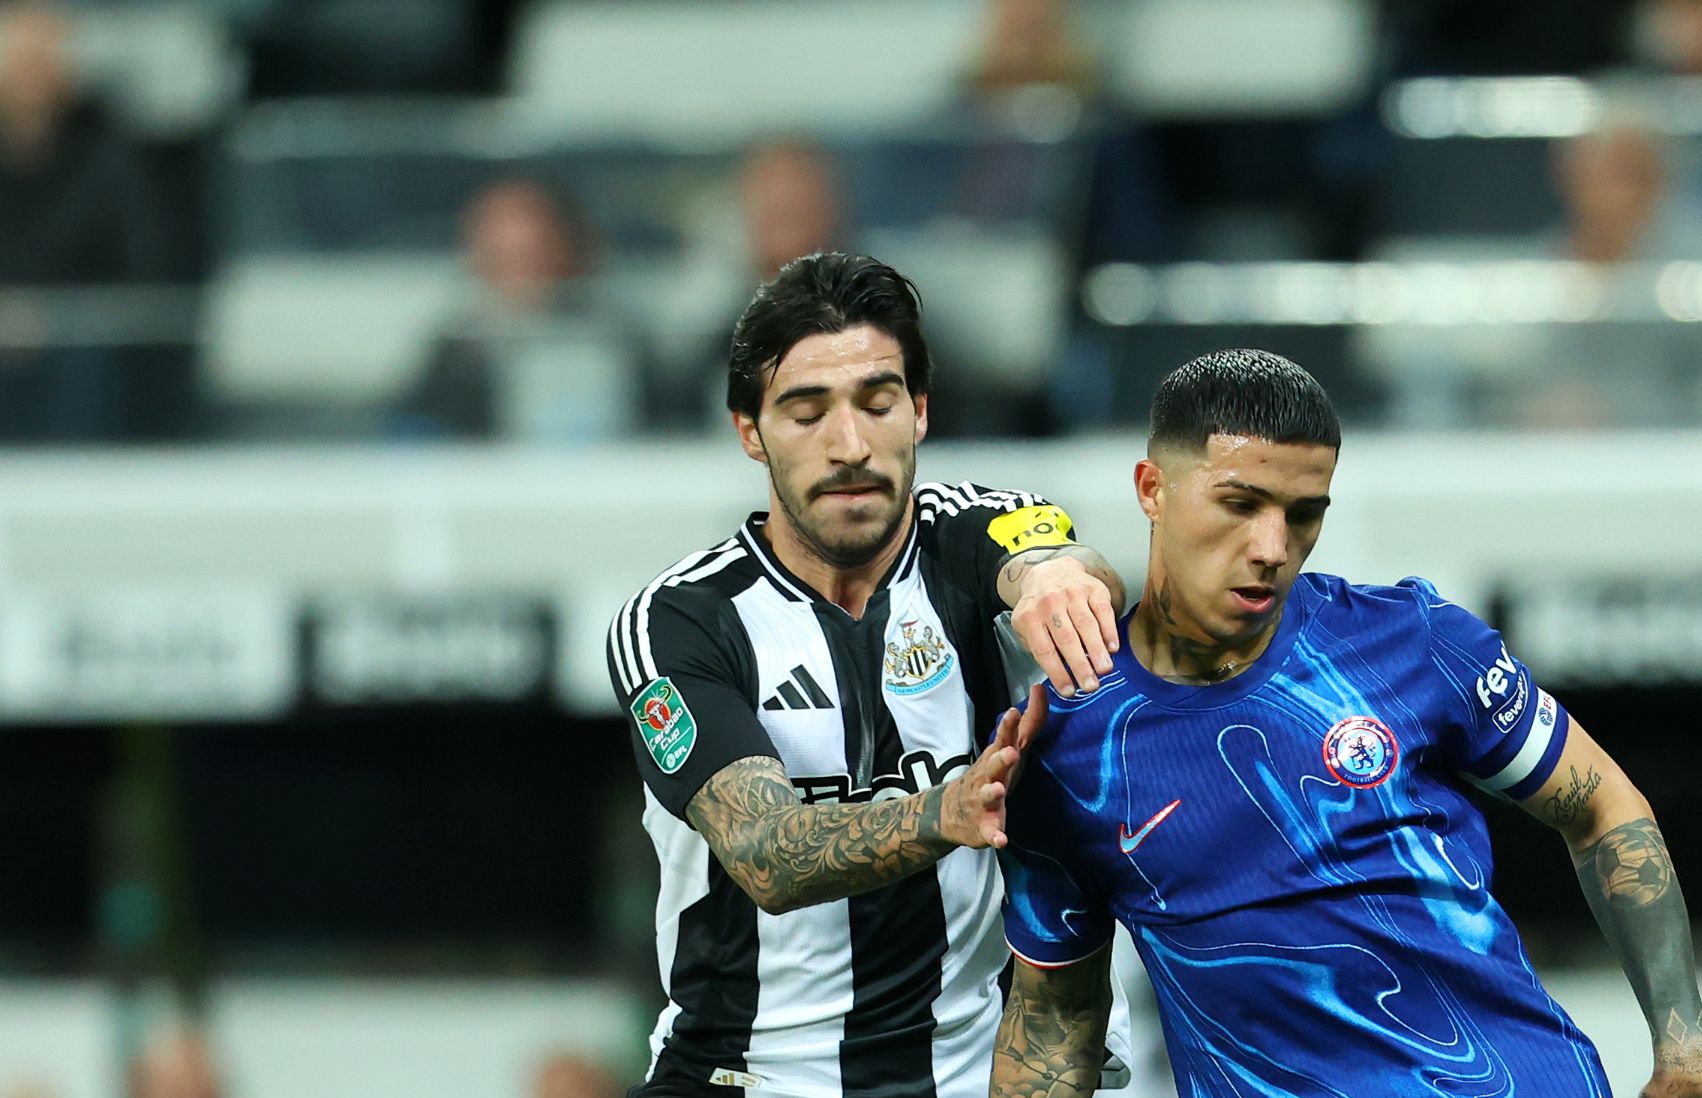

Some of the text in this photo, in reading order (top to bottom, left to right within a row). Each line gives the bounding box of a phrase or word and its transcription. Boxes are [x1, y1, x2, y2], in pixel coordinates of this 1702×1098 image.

[649, 707, 683, 752] Carabao
[661, 728, 680, 750] Cup
[675, 745, 687, 758] EFL
